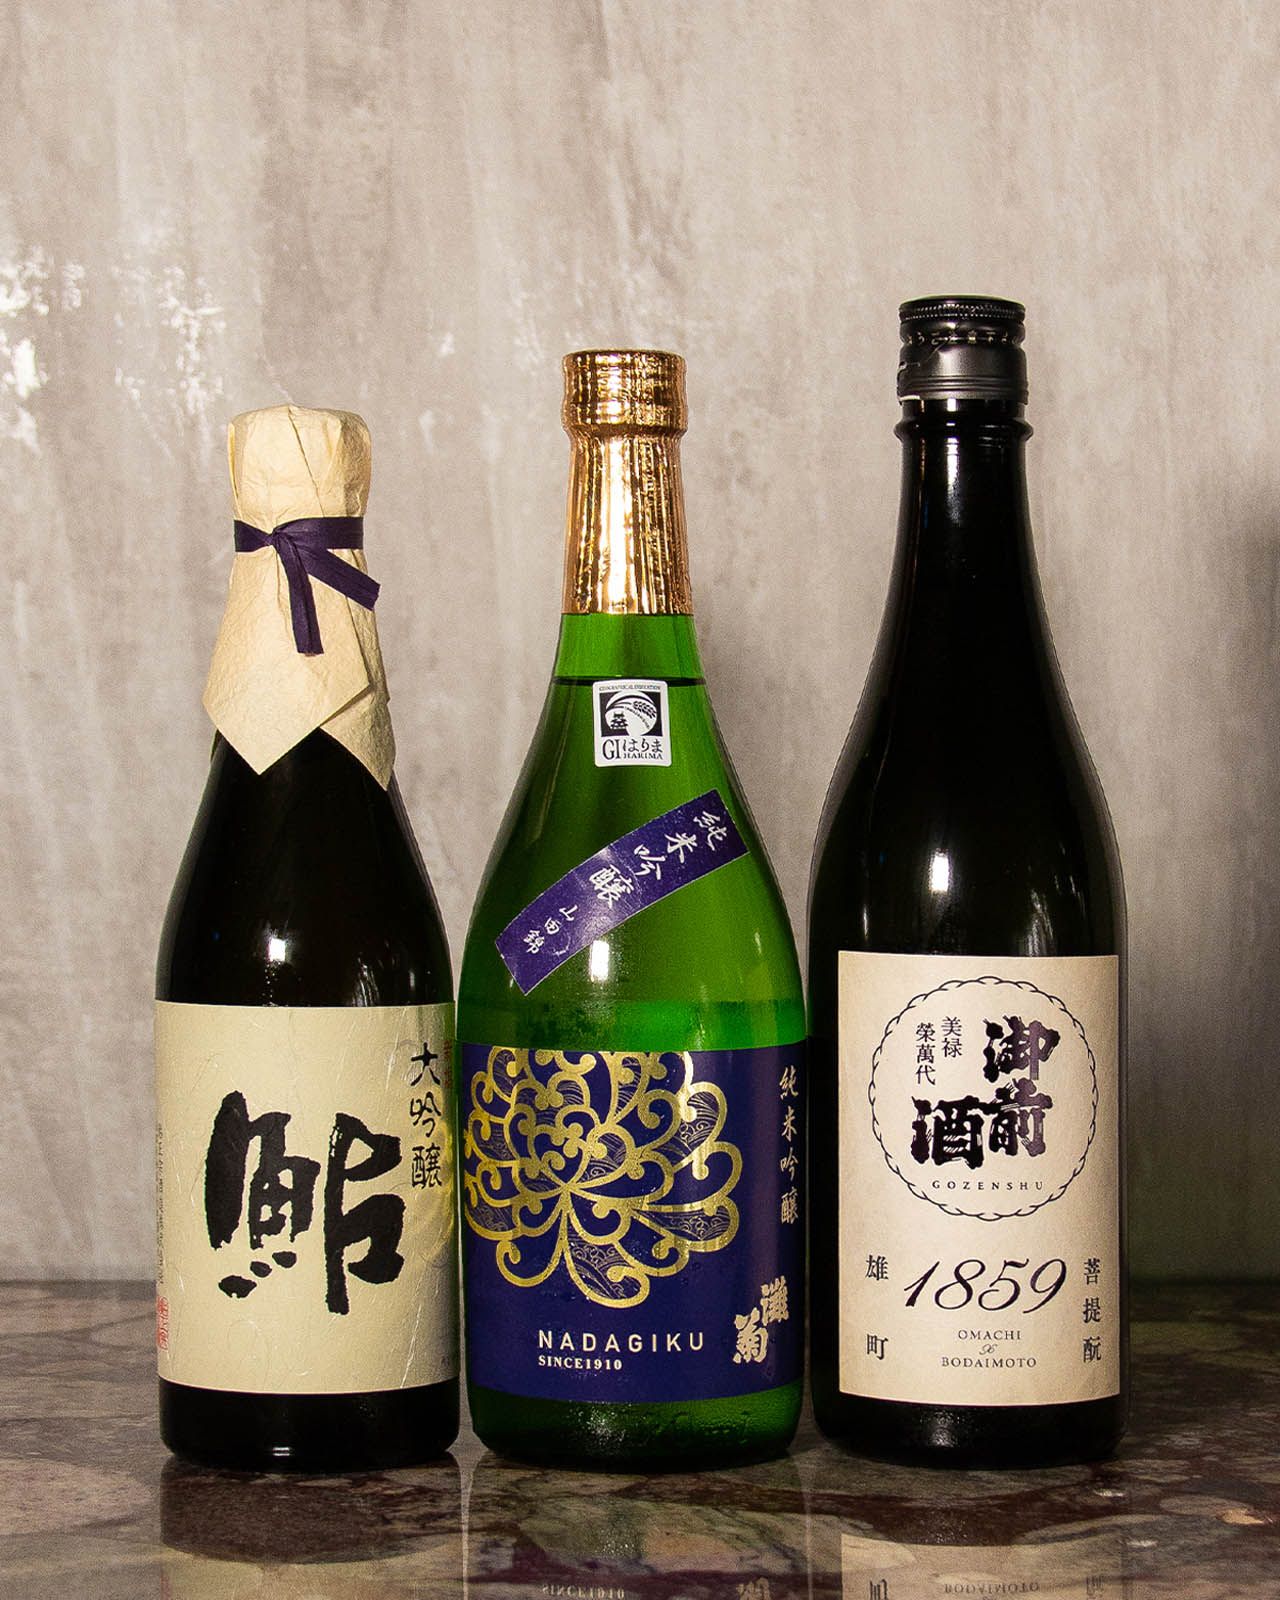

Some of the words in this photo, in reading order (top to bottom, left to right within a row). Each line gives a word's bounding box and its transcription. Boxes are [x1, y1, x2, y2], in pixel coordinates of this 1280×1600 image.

[602, 739, 621, 760] GI
[622, 738, 663, 753] はりま
[623, 752, 663, 760] HARIMA
[410, 1042, 442, 1189] 大吟醸
[779, 1064, 799, 1225] 純米吟醸
[932, 1180, 1044, 1190] GOZENSHU
[903, 1258, 1067, 1314] 1859
[865, 1254, 889, 1361] 雄町
[538, 1329, 704, 1353] NADAGIKU
[957, 1329, 1022, 1341] OMACHI
[538, 1355, 623, 1370] SINCE1910
[941, 1356, 1037, 1368] BODAIMOTO
